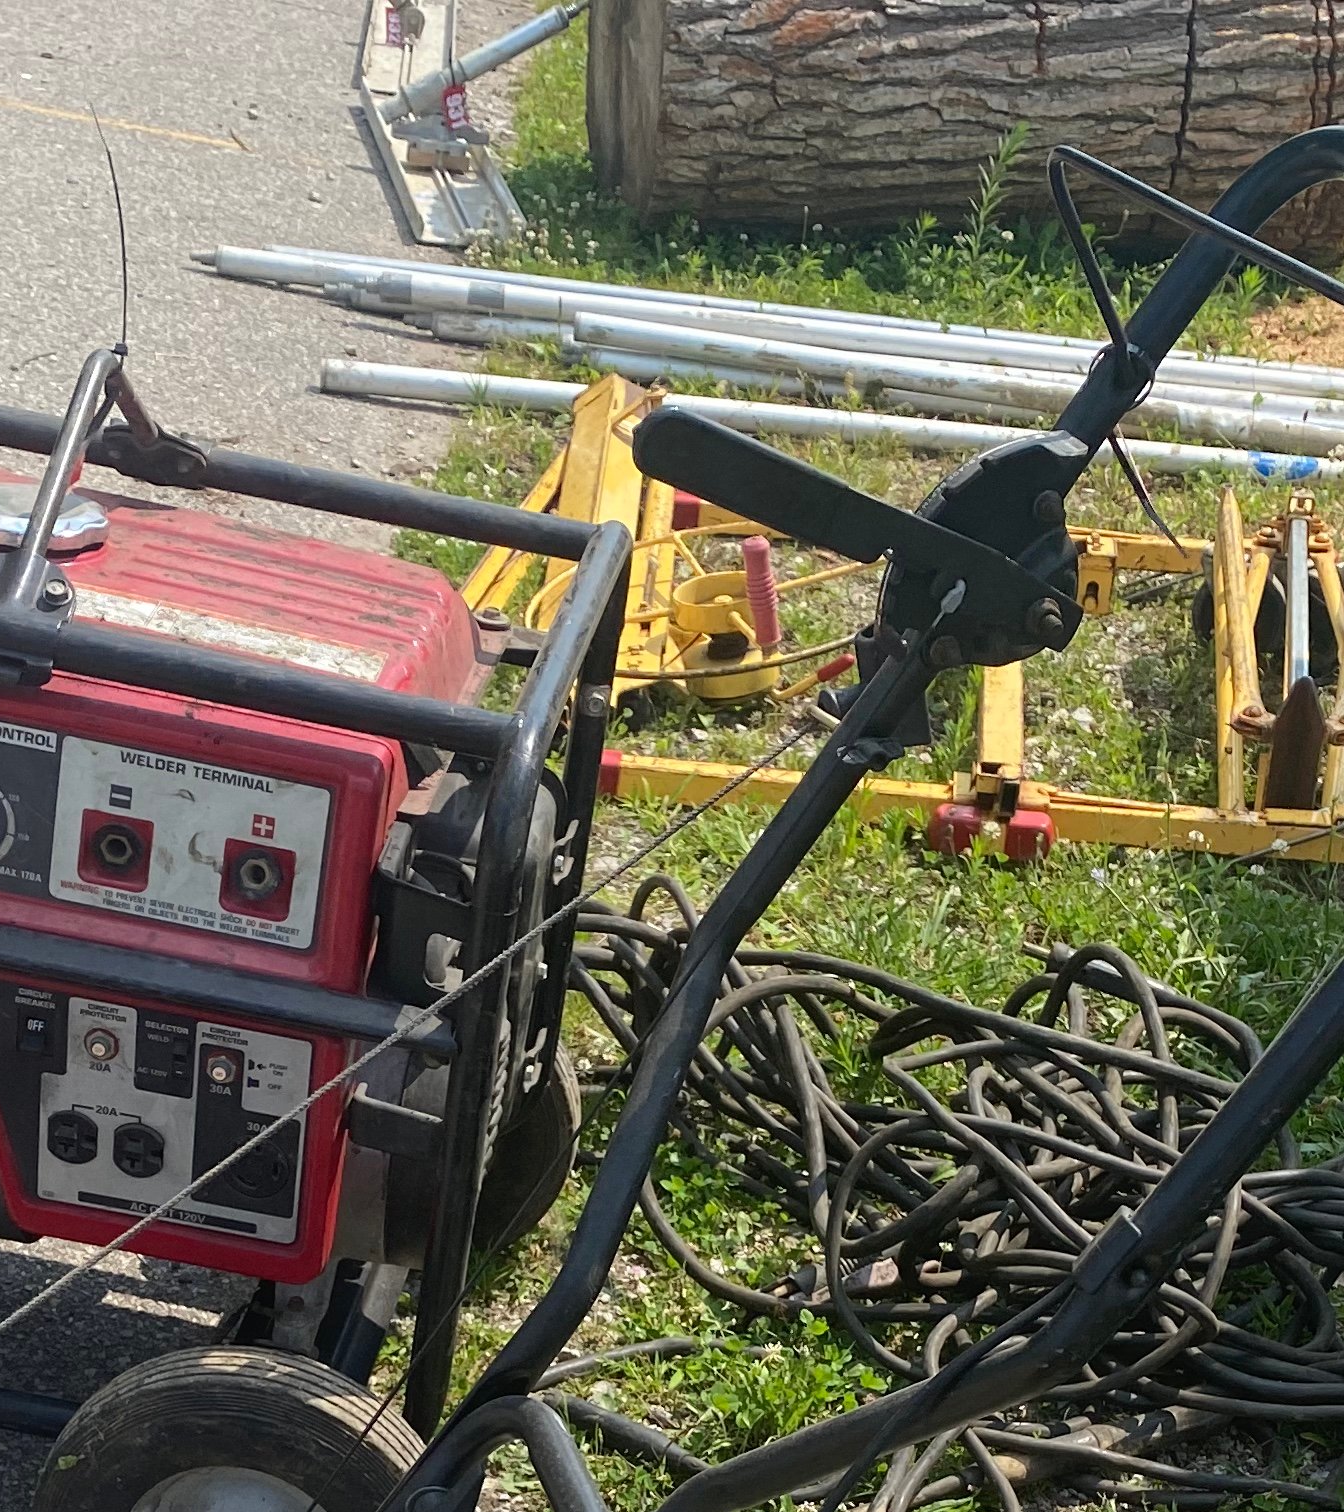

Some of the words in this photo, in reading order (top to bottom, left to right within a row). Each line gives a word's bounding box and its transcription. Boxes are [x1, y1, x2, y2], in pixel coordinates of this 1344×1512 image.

[120, 750, 186, 775] WELDER
[192, 765, 274, 793] TERMINAL
[18, 987, 53, 1000] CIRCUIT
[15, 996, 55, 1010] BREAKER
[80, 1009, 126, 1022] PROTECTOR
[27, 1019, 44, 1032] OFF
[145, 1020, 189, 1035] SELECTOR
[202, 1032, 248, 1046] PROTECTOR
[89, 1062, 111, 1072] 20A
[210, 1084, 231, 1096] 30A
[95, 1105, 118, 1117] 20A
[130, 1202, 146, 1212] AC
[178, 1212, 205, 1224] 120V
